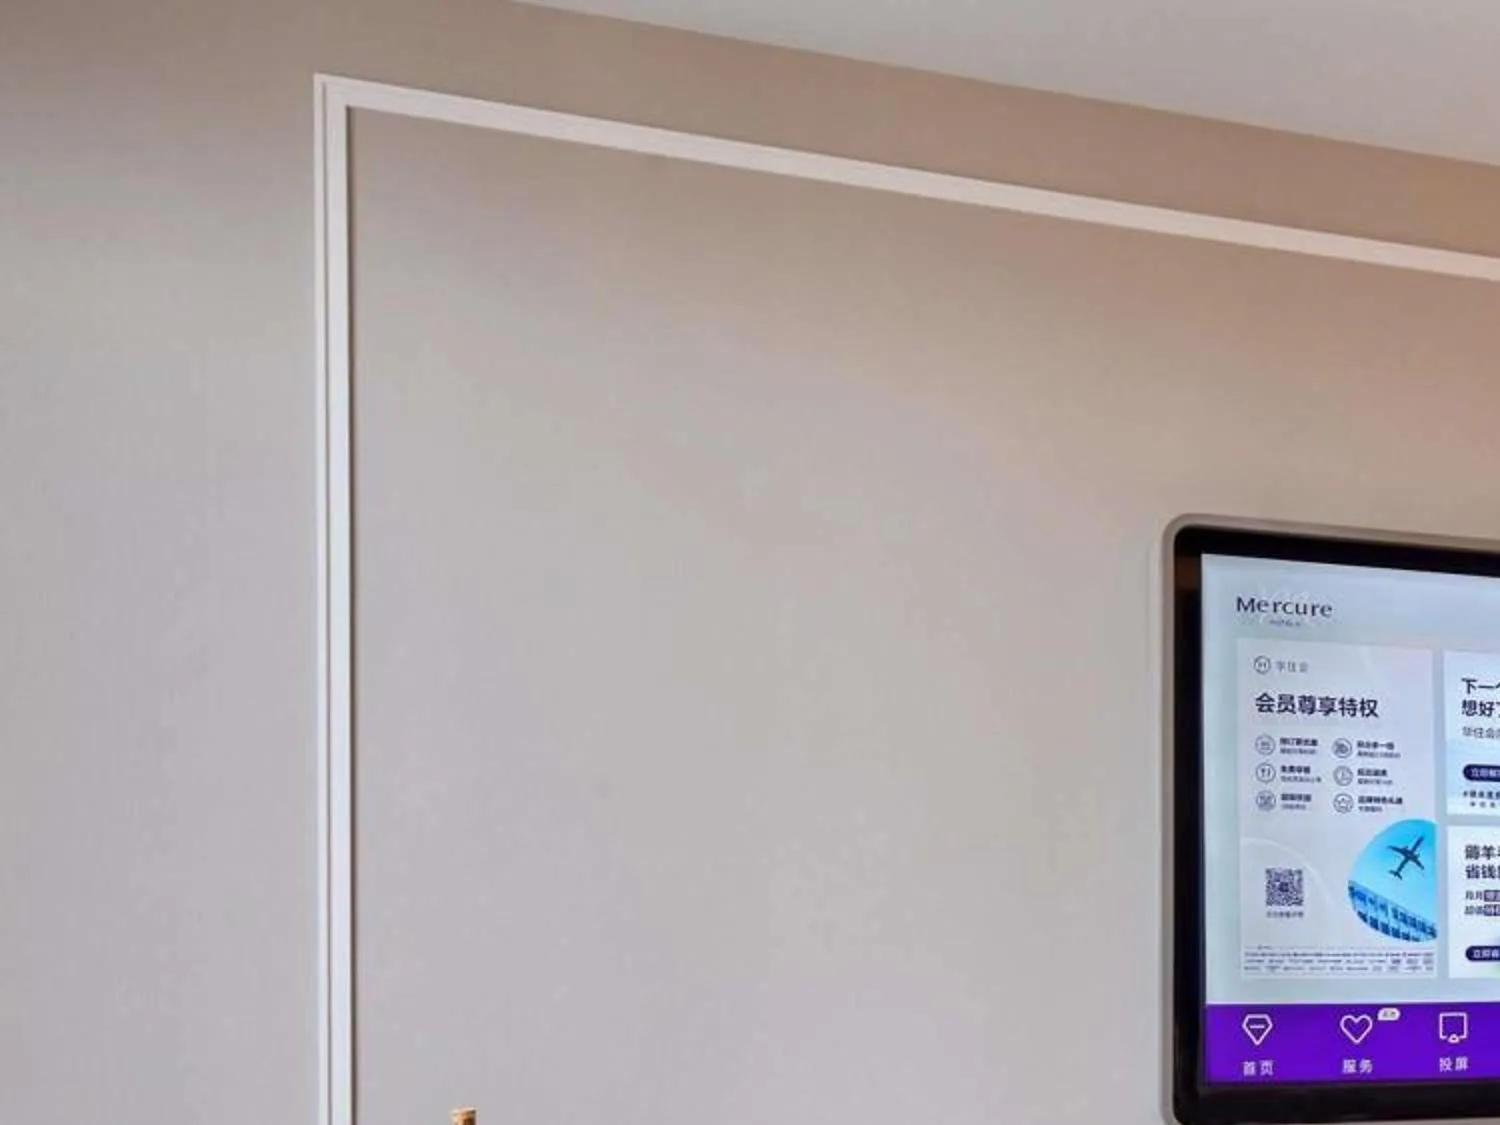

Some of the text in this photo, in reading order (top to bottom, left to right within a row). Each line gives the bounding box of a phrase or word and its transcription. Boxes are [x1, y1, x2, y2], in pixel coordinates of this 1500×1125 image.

[1236, 596, 1333, 618] Mercure
[1255, 692, 1380, 718] 会员尊享特权
[1242, 1060, 1274, 1077] 首页
[1342, 1059, 1373, 1074] 服务
[1439, 1056, 1469, 1073] 投屏
